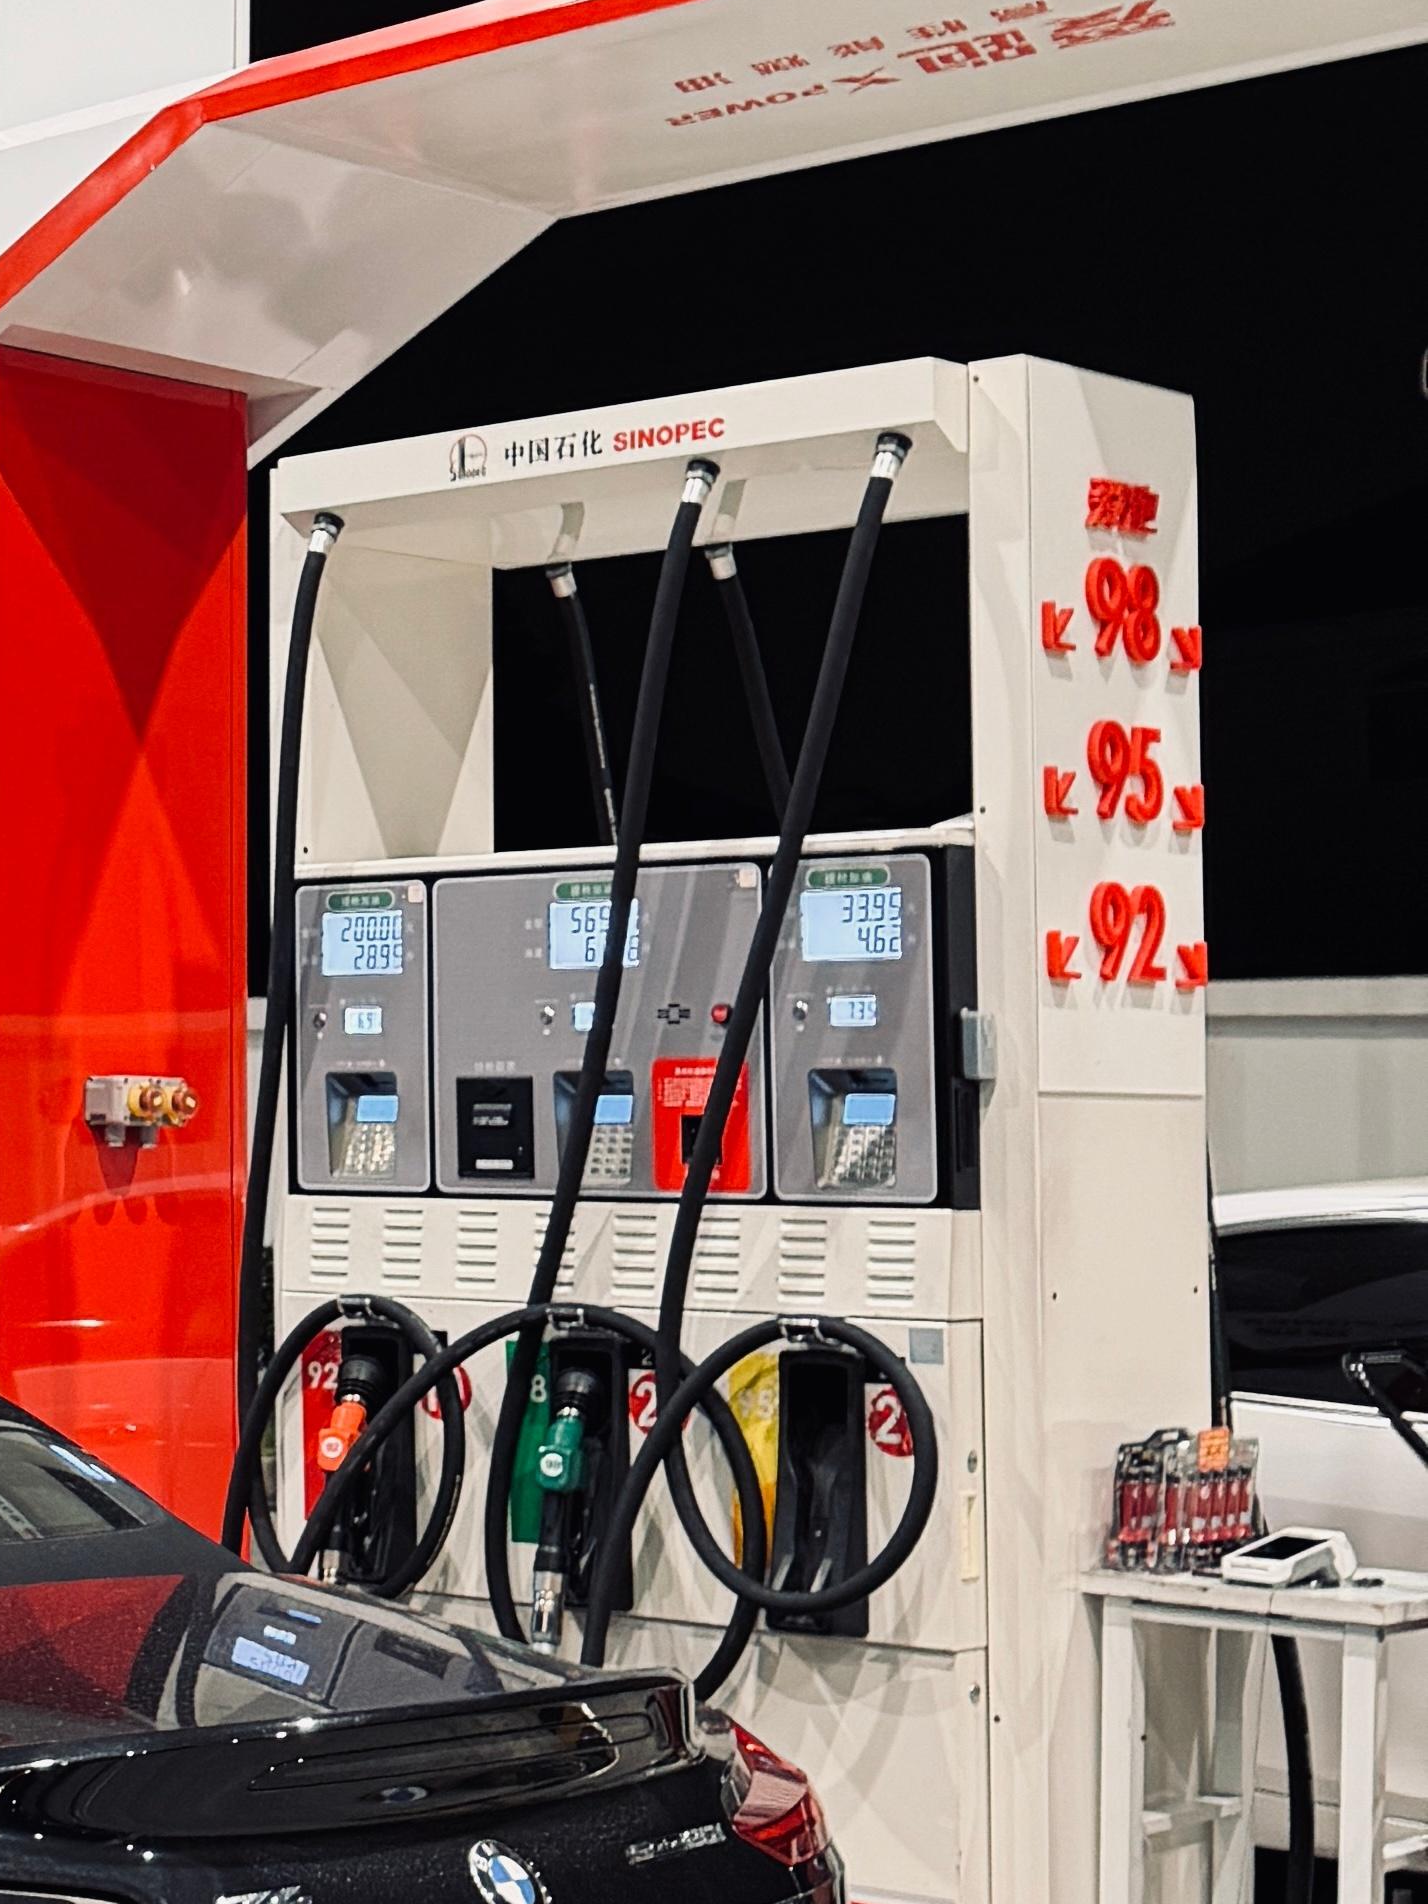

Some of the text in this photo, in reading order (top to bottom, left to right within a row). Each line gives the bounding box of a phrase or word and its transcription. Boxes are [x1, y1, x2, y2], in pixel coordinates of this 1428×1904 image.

[504, 417, 726, 467] 中国石化 SINOPEC
[1084, 556, 1161, 666] 98
[1086, 720, 1163, 825] 95
[1089, 881, 1167, 986] 92
[307, 1361, 340, 1389] 92
[529, 1374, 548, 1403] 8
[635, 1381, 657, 1427] 2
[875, 1395, 902, 1444] 2
